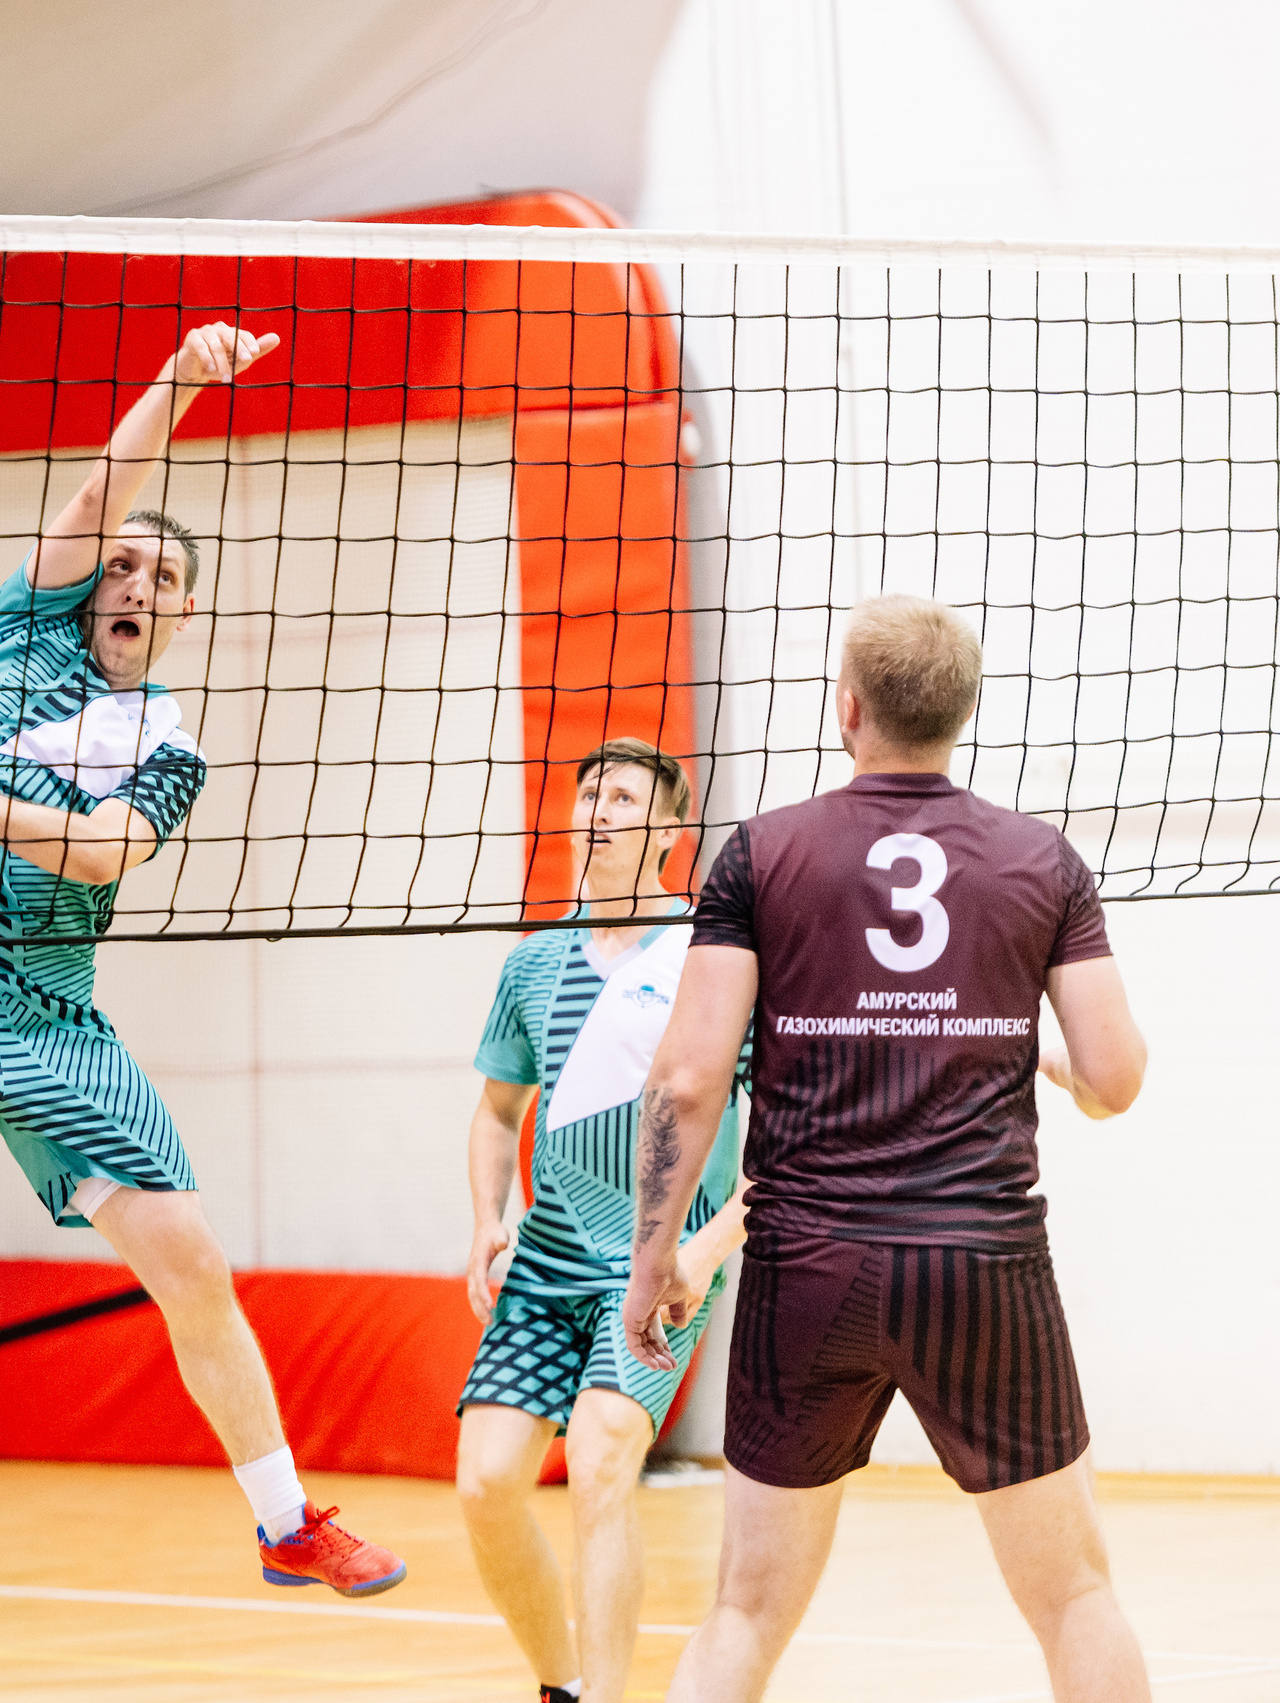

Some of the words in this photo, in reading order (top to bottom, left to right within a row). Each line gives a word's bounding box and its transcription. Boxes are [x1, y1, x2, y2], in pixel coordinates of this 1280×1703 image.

[865, 833, 950, 972] 3
[856, 987, 958, 1010] АМУРСКИЙ
[776, 1014, 937, 1036] ГАЗОХИМИЧЕСКИЙ
[942, 1018, 1031, 1036] КОМПЛЕКС
